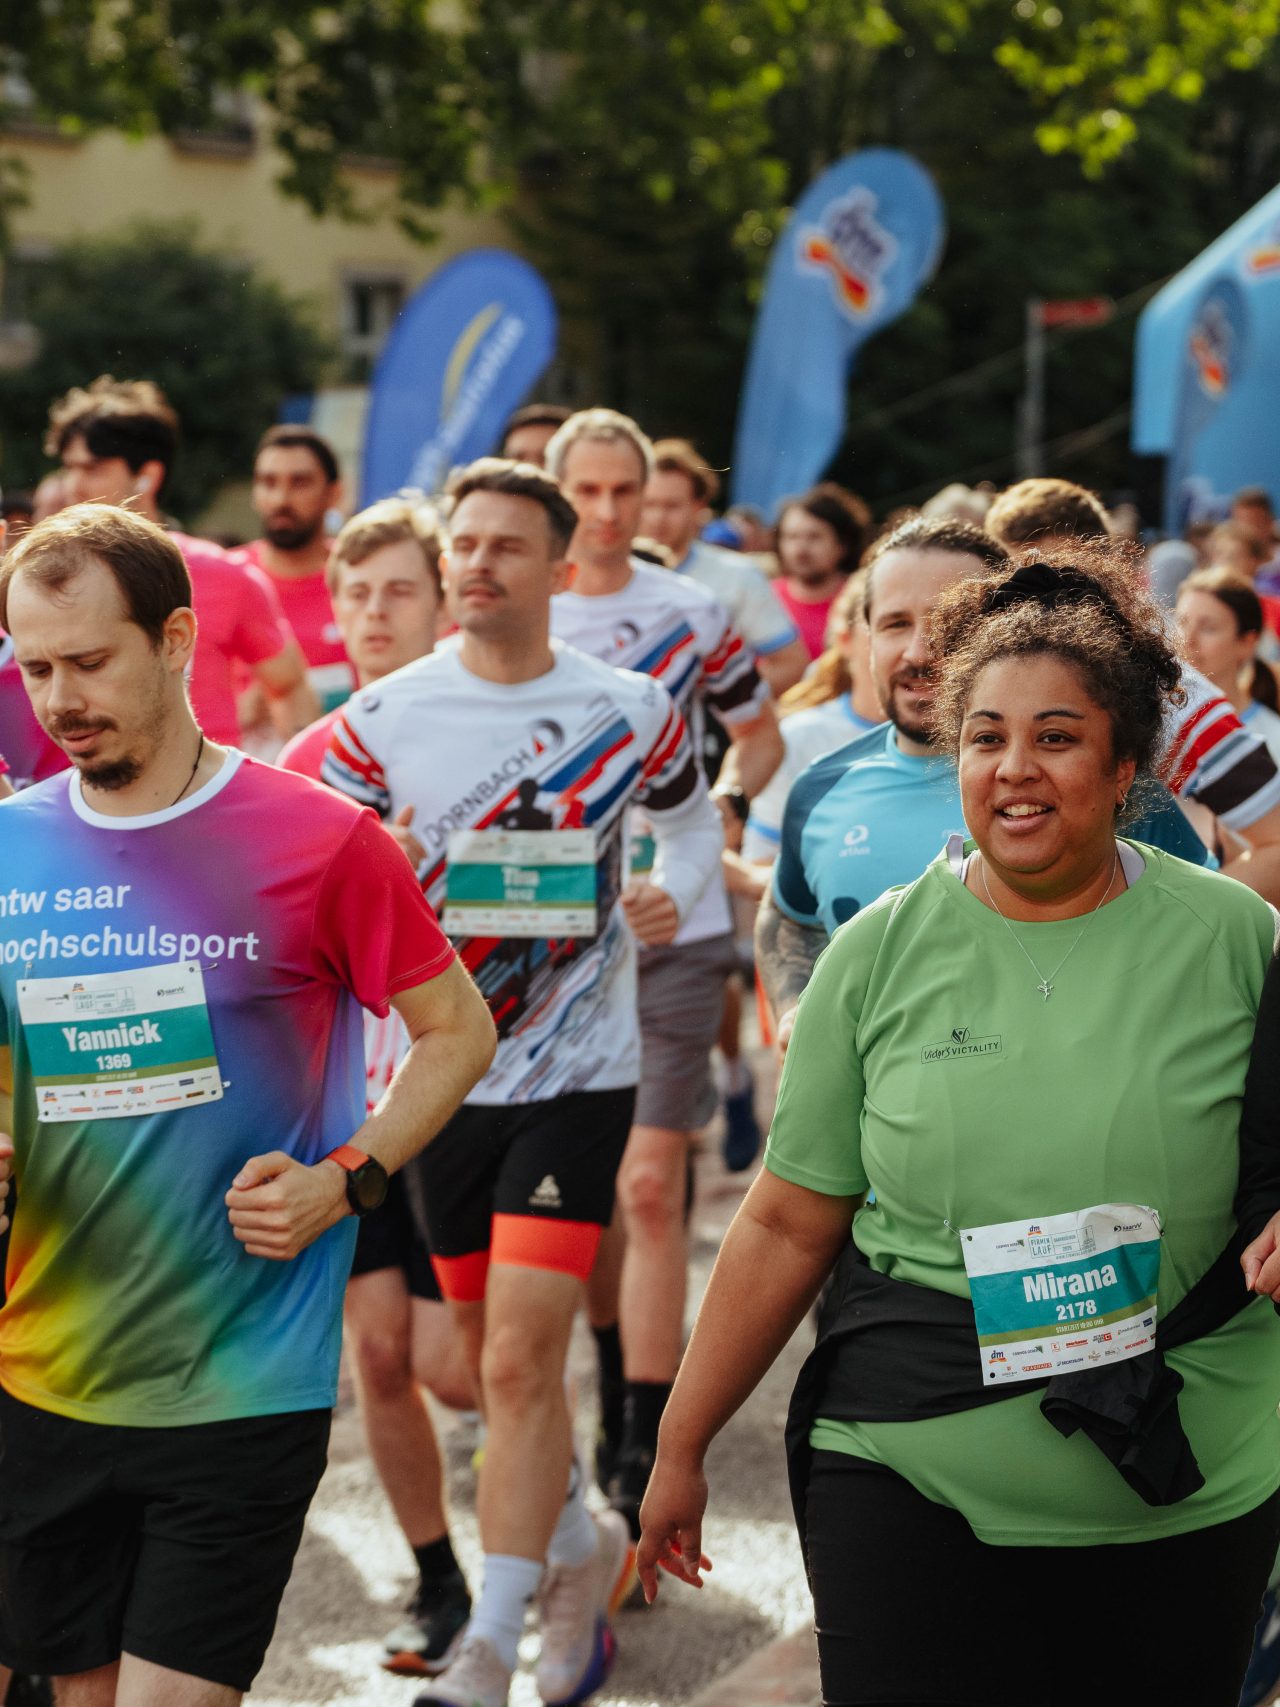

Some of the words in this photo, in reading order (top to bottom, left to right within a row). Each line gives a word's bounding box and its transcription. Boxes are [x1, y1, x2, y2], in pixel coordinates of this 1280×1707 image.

[423, 749, 531, 848] DORNBACH
[54, 885, 131, 912] saar
[0, 925, 259, 964] ochschulsport
[62, 1019, 162, 1053] Yannick
[951, 1041, 999, 1055] VICTALITY
[96, 1053, 132, 1071] 1369
[1032, 1245, 1052, 1256] LAUF
[1022, 1264, 1118, 1303] Mirana
[1056, 1299, 1097, 1321] 2178
[990, 1350, 1004, 1359] dm
